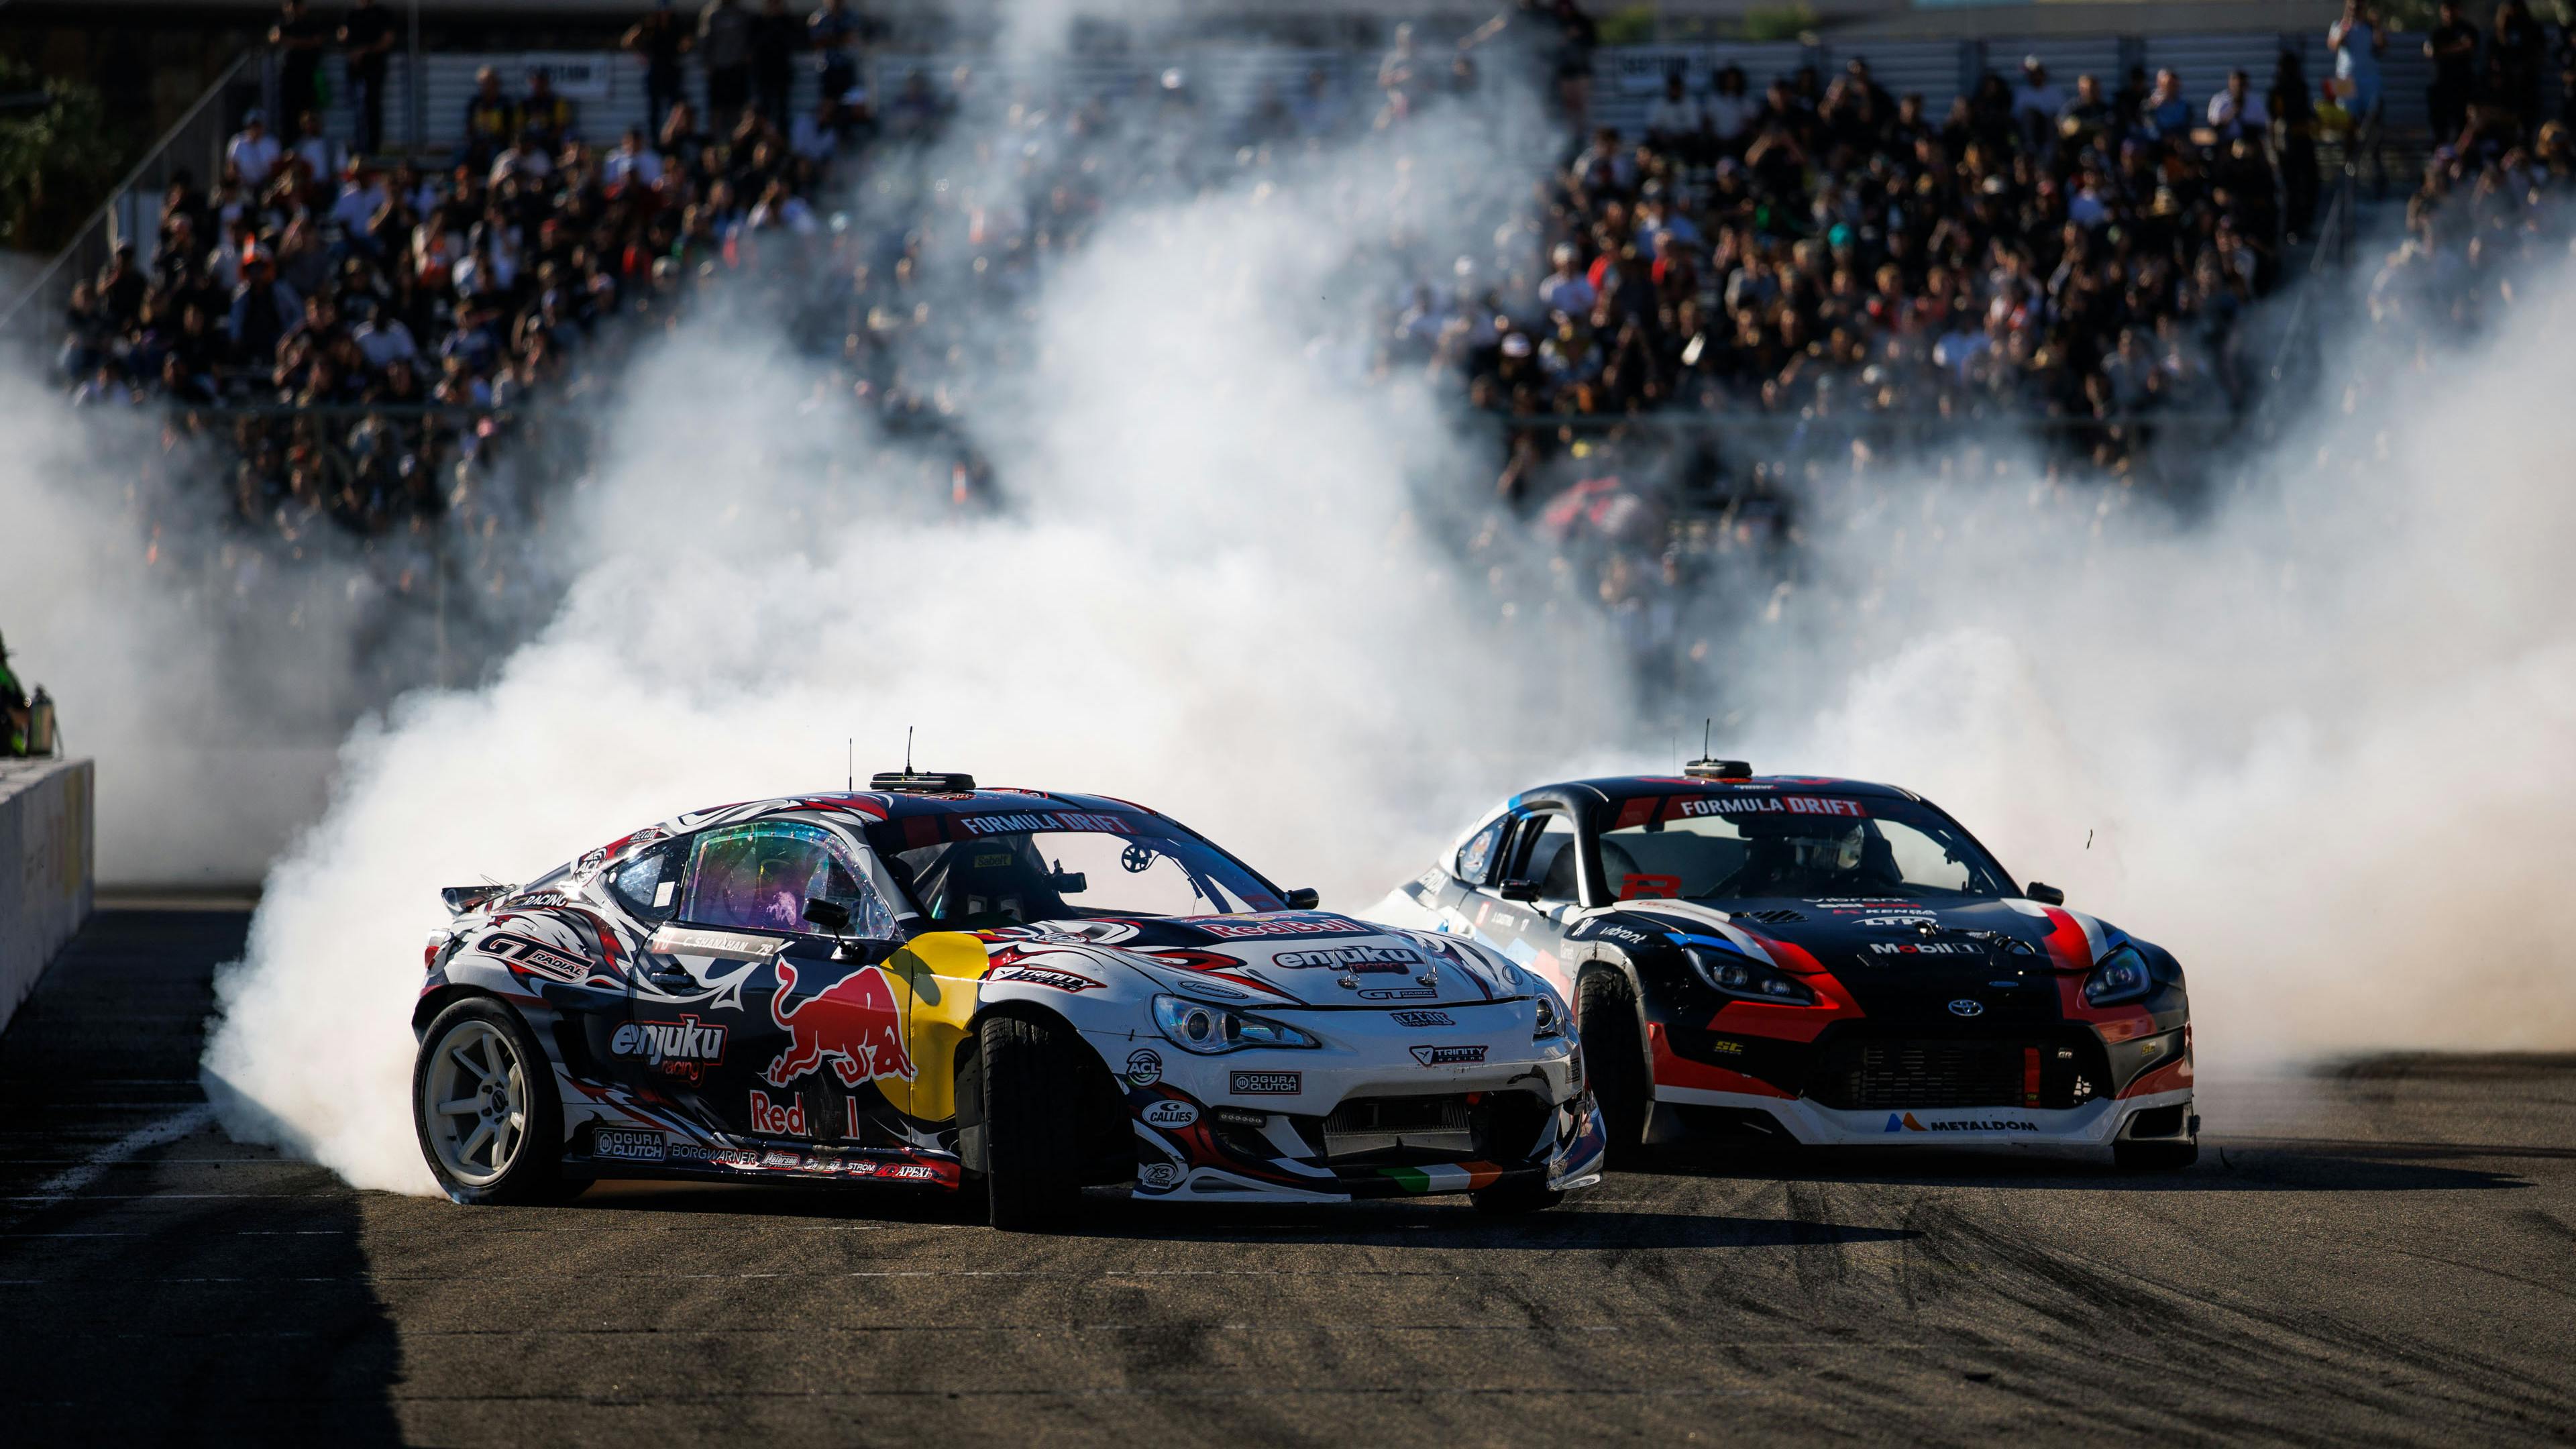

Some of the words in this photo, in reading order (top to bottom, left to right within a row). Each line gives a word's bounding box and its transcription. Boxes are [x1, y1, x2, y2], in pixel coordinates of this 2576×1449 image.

[1680, 799, 1784, 816] FORMULA
[1788, 798, 1860, 816] DRIFT
[961, 814, 1065, 835] FORMULA
[1061, 812, 1132, 834] DRIFT
[521, 894, 566, 907] RACING
[1196, 922, 1297, 938] Red
[1273, 919, 1370, 933] Bull
[1599, 925, 1648, 944] vibrant
[756, 943, 773, 957] 79
[1870, 943, 1953, 955] Mobil
[533, 952, 579, 975] RADIAL
[1277, 946, 1416, 968] enjuku
[1022, 969, 1097, 989] TRINITY
[611, 1018, 723, 1065] enjuku
[1435, 1047, 1486, 1056] TRINITY
[2057, 1050, 2073, 1059] GR
[661, 1060, 700, 1081] racing
[1129, 1062, 1161, 1074] ACL
[1250, 1075, 1296, 1083] OGURA
[1250, 1083, 1297, 1091] CLUTCH
[750, 1089, 806, 1136] Red
[1149, 1111, 1192, 1123] CALLIES
[1931, 1120, 2038, 1132] METALDOM
[613, 1133, 662, 1146] OGURA
[612, 1145, 663, 1157] CLUTCH
[672, 1145, 757, 1165] BORGWARNER
[764, 1152, 798, 1165] Peterson
[847, 1161, 875, 1171] STRÖM
